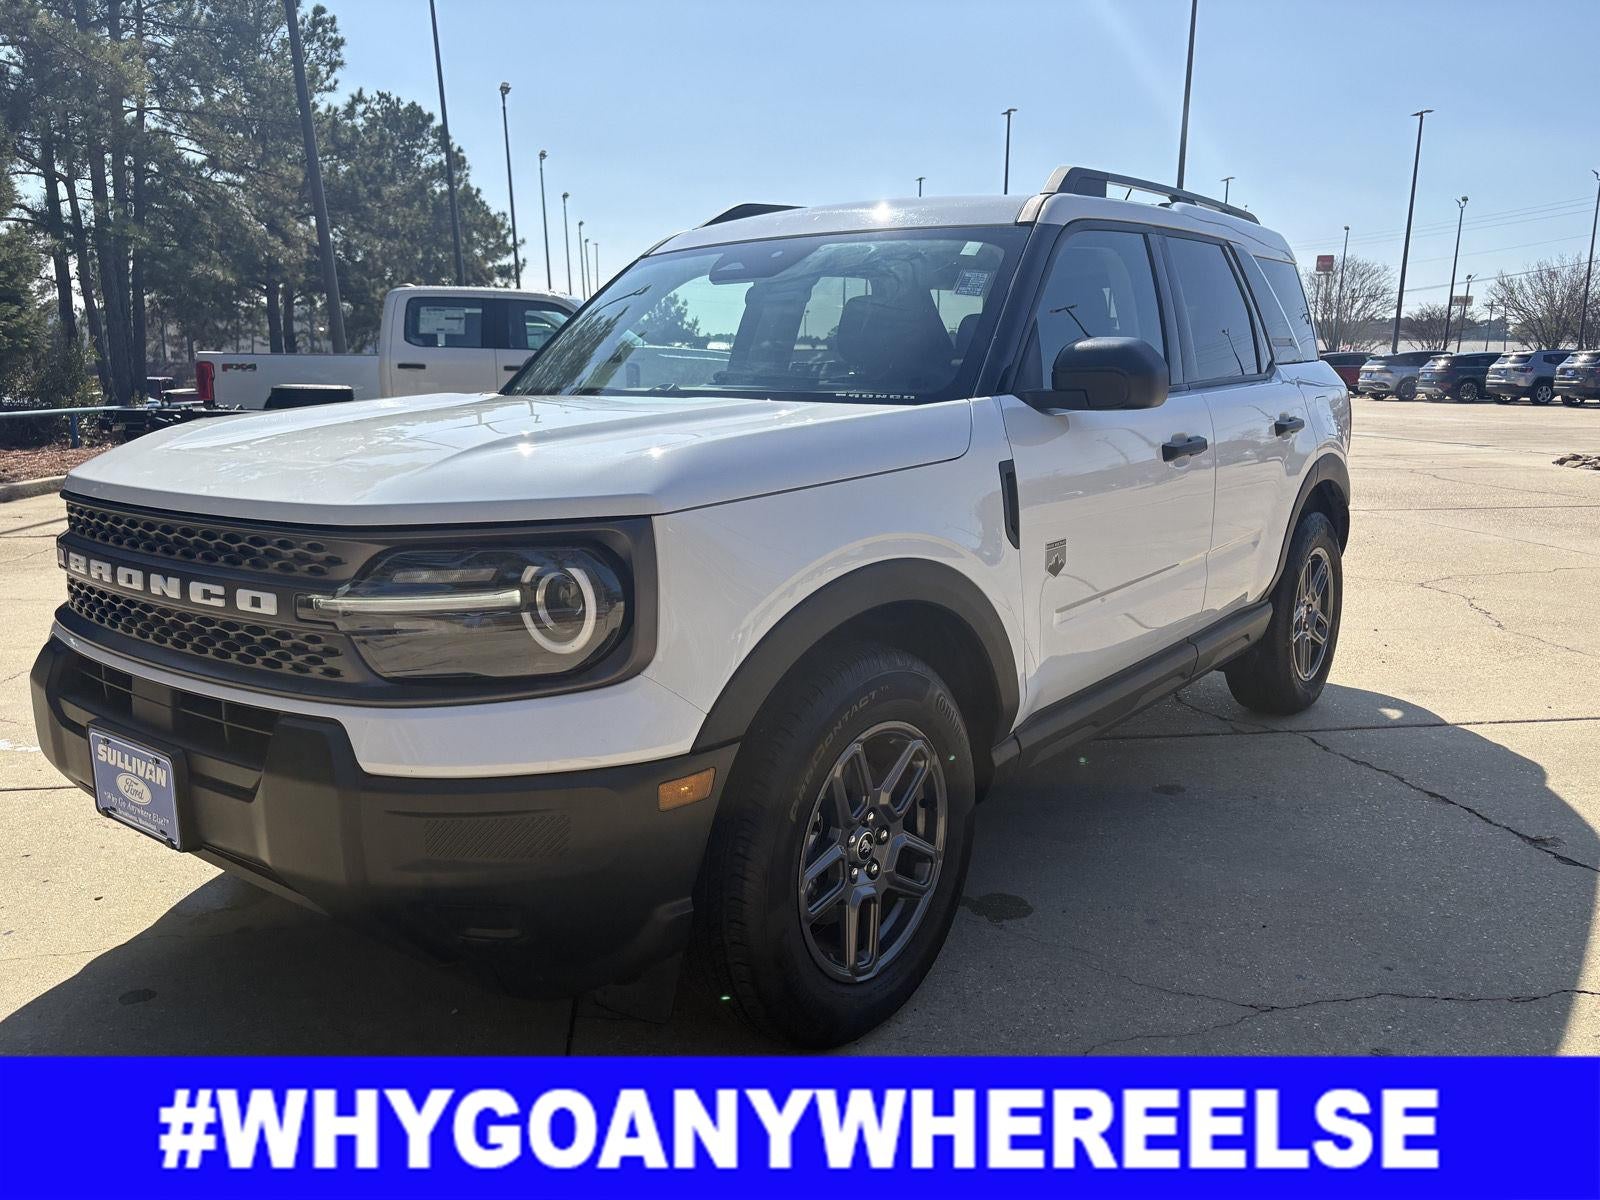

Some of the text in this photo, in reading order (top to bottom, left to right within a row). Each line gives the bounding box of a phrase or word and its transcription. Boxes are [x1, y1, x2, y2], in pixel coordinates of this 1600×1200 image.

[221, 363, 257, 372] FX4
[68, 551, 278, 616] BRONCO
[97, 744, 167, 788] SULLIVAN
[124, 777, 144, 801] Ford
